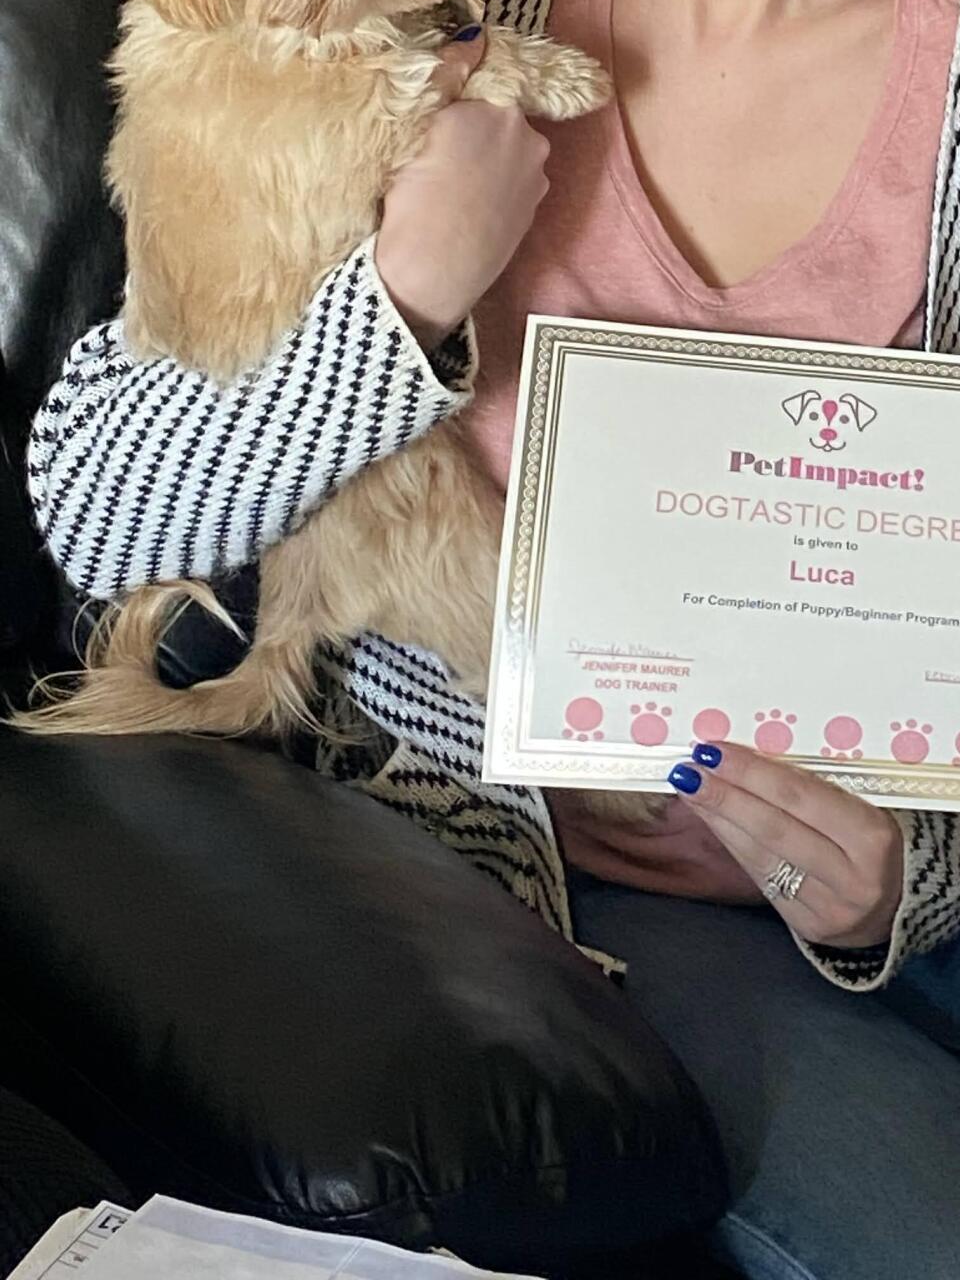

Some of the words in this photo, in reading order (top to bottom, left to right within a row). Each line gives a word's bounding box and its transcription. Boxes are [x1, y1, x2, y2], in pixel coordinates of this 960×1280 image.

[727, 450, 925, 492] PetImpact!
[655, 490, 846, 530] DOGTASTIC
[793, 535, 804, 547] is
[808, 538, 842, 551] given
[846, 541, 859, 551] to
[789, 560, 855, 586] Luca
[683, 593, 704, 606] For
[708, 595, 781, 612] Completion
[784, 601, 798, 613] of
[801, 602, 902, 623] Puppy/Beginner
[905, 612, 960, 628] Program
[581, 660, 637, 673] JENNIFER
[640, 664, 690, 677] MAURER
[594, 678, 622, 690] DOG
[625, 680, 678, 693] TRAINER
